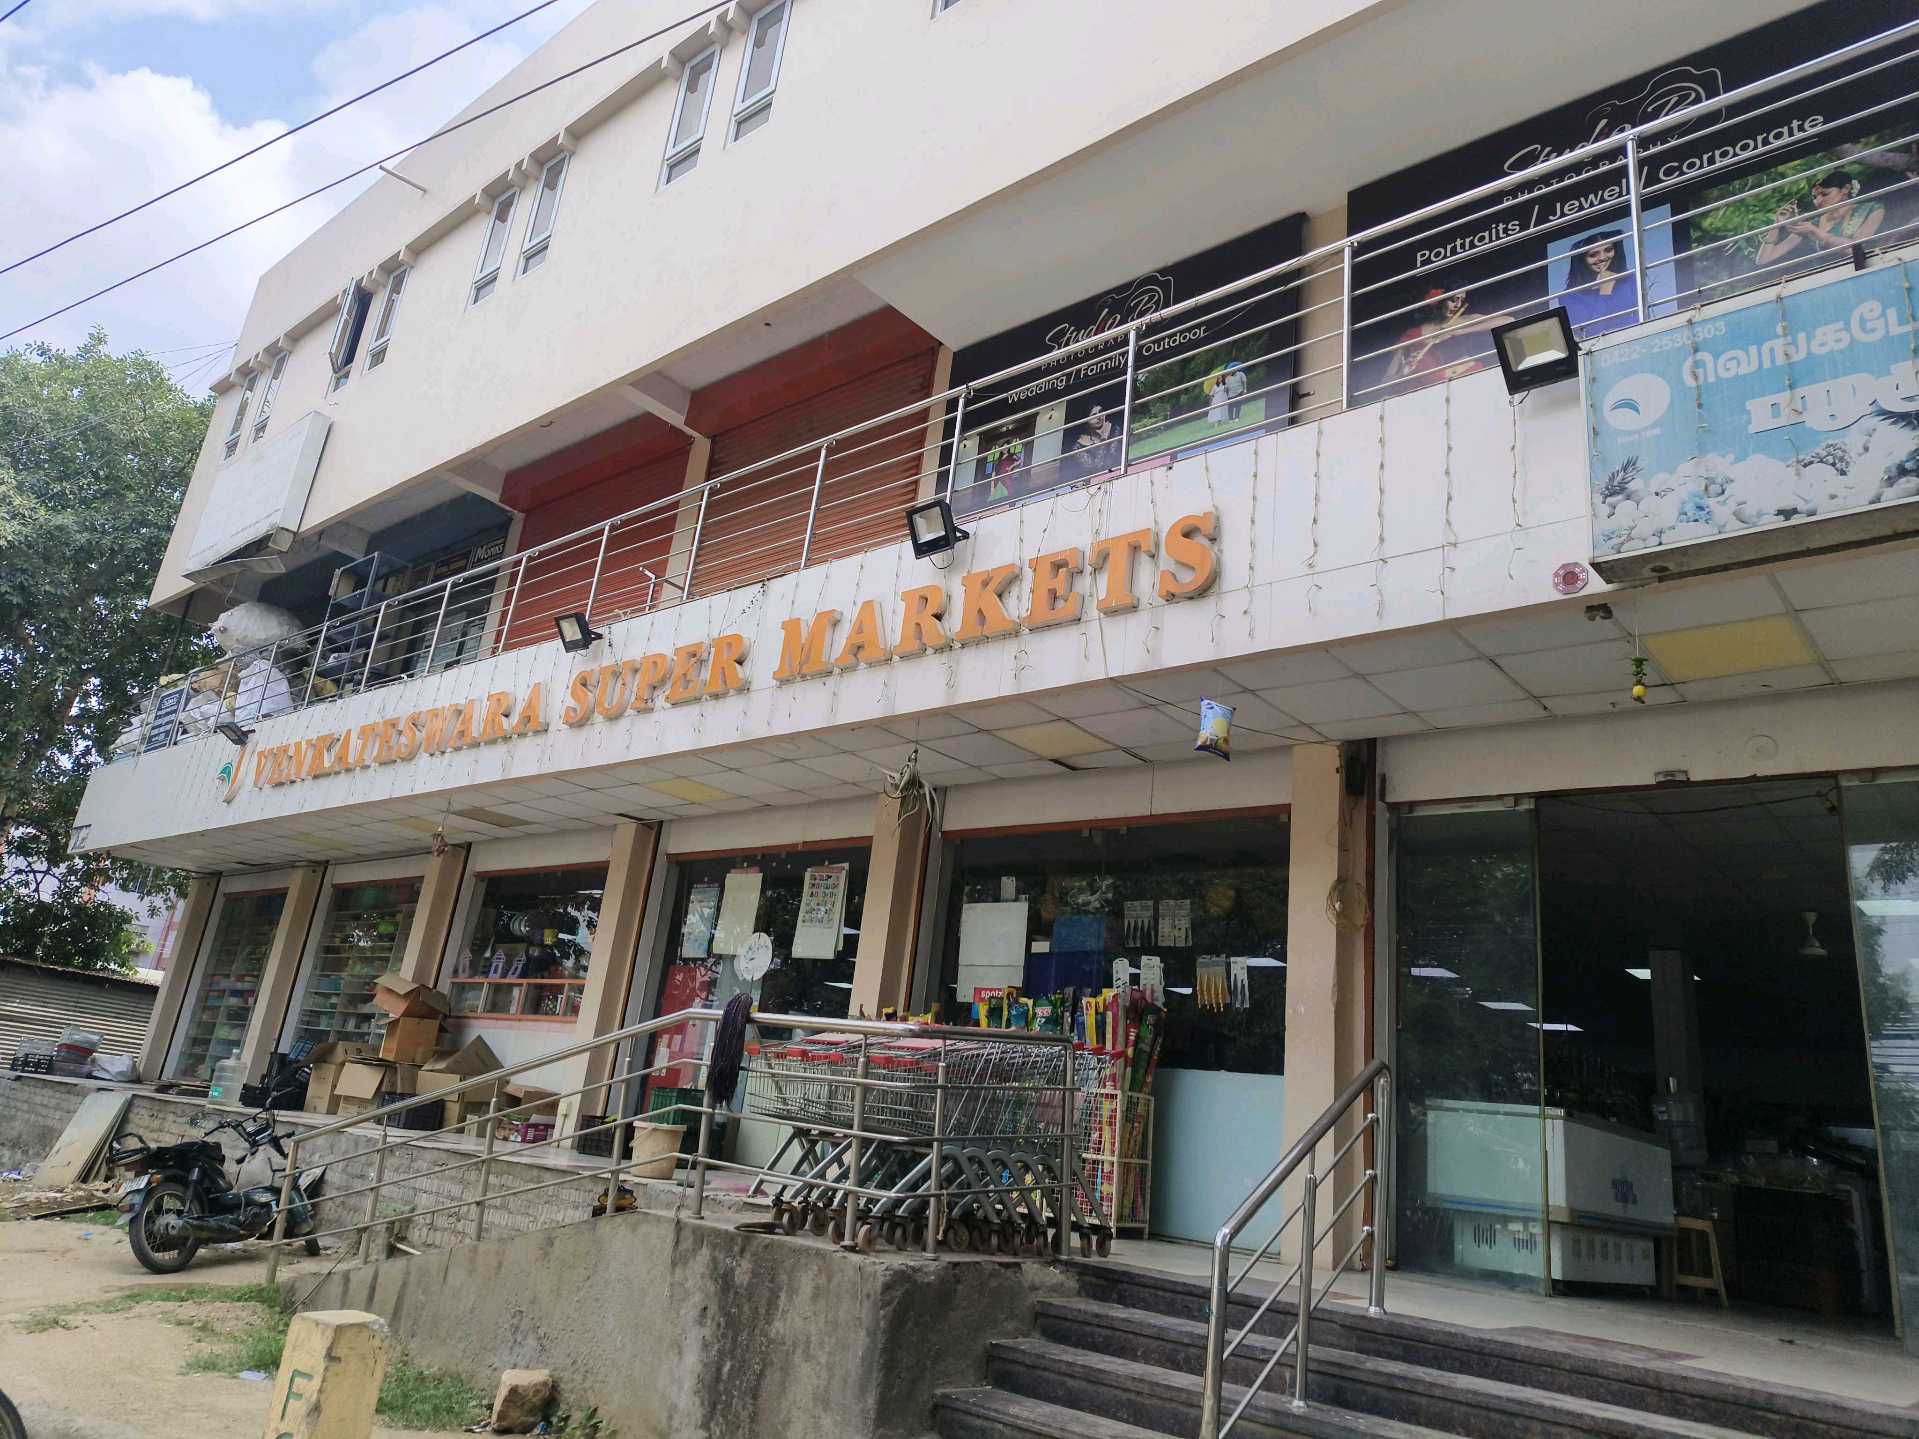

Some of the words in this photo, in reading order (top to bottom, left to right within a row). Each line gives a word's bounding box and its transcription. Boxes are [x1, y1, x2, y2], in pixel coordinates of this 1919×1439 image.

[1414, 218, 1521, 268] Portraits
[1548, 178, 1628, 221] Jewel
[1658, 112, 1826, 182] Corporate
[1007, 375, 1067, 404] Wedding
[1080, 352, 1128, 379] Family
[1142, 326, 1208, 356] Outdoor
[253, 682, 549, 790] VENKATESWARA
[561, 632, 750, 728] SUPER
[772, 510, 1219, 683] MARKETS
